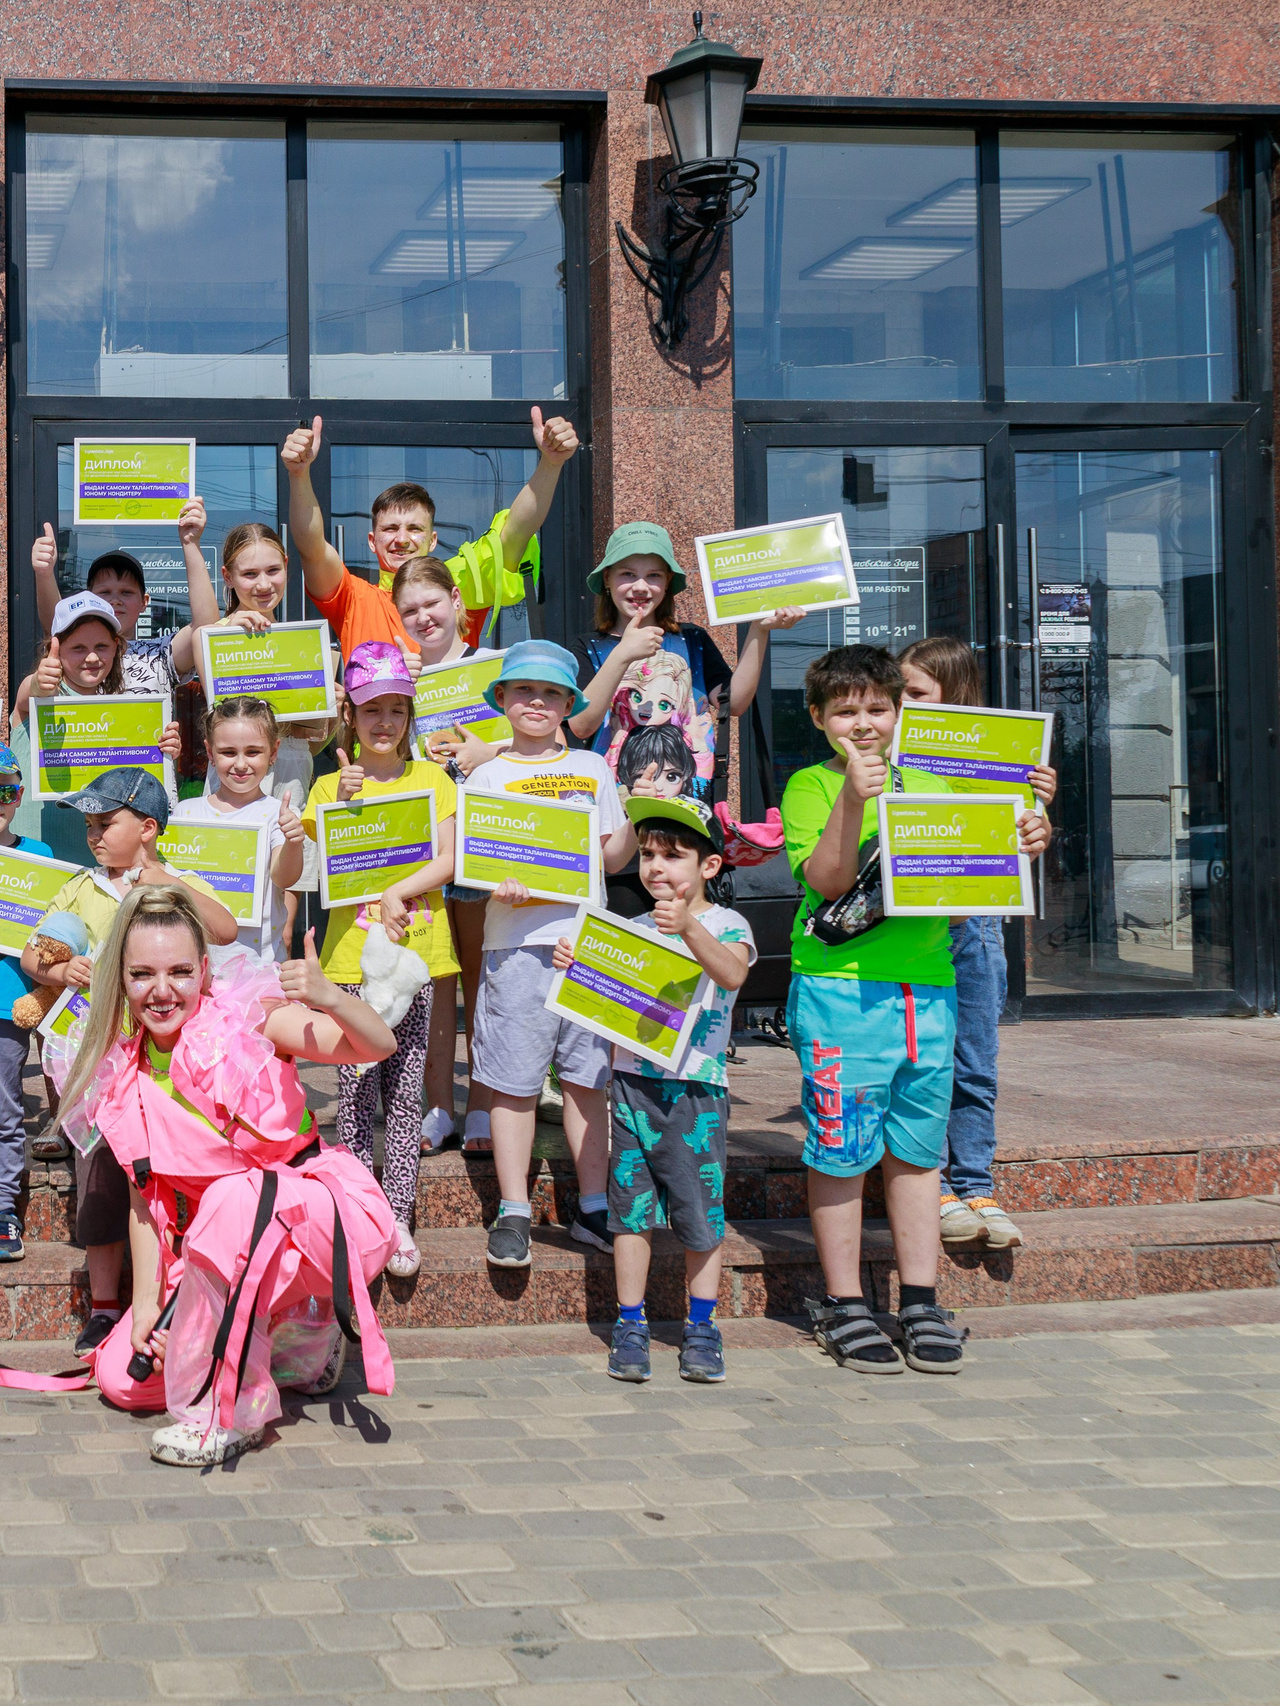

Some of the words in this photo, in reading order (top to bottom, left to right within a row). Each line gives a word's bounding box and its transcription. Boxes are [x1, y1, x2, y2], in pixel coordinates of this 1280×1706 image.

[84, 460, 142, 470] ДИПЛОМ
[714, 547, 781, 568] ДИПЛОМ
[894, 558, 919, 572] Зори
[718, 579, 742, 587] ВЫДАН
[743, 575, 772, 583] САМОМУ
[719, 585, 745, 593] ЮНОМУ
[746, 578, 786, 588] КОНДИТЕРУ
[875, 585, 910, 593] РАБОТЫ
[216, 649, 274, 664] ДИПЛОМ
[267, 674, 313, 682] ТАЛАНТЛИВОМУ
[44, 722, 109, 735] ДИПЛОМ
[906, 727, 981, 743] ДИПЛОМ
[931, 759, 963, 767] САМОМУ
[965, 762, 1023, 773] ТАЛАНТЛИВОМУ
[933, 767, 976, 775] КОНДИТЕРУ
[521, 781, 590, 790] GENERATION
[470, 812, 536, 831] ДИПЛОМ
[329, 822, 386, 841] ДИПЛОМ
[894, 825, 962, 838] ДИПЛОМ
[156, 842, 200, 855] ПЛОМ
[469, 840, 493, 848] ВЫДАН
[494, 844, 523, 853] САМОМУ
[524, 848, 576, 861] ТАЛАНТЛИВОМУ
[469, 847, 495, 855] ЮНОМУ
[496, 851, 535, 861] КОНДИТЕРУ
[331, 857, 352, 865] ВЫДАН
[352, 854, 377, 862] САМОМУ
[378, 847, 422, 858] ТАЛАНТЛИВОМУ
[331, 864, 354, 872] ЮНОМУ
[355, 859, 388, 868] КОНДИТЕРУ
[198, 874, 241, 883] АНТЛИВОМУ
[15, 907, 44, 919] ТАЛАНТЛ
[412, 927, 427, 937] box
[581, 935, 645, 971] ДИПЛОМ
[573, 964, 595, 979] ВЫДАН
[595, 975, 622, 991] САМОМУ
[571, 971, 594, 986] ЮНОМУ
[594, 983, 631, 1004] КОНДИТЕРУ
[812, 1039, 844, 1148] HEAT
